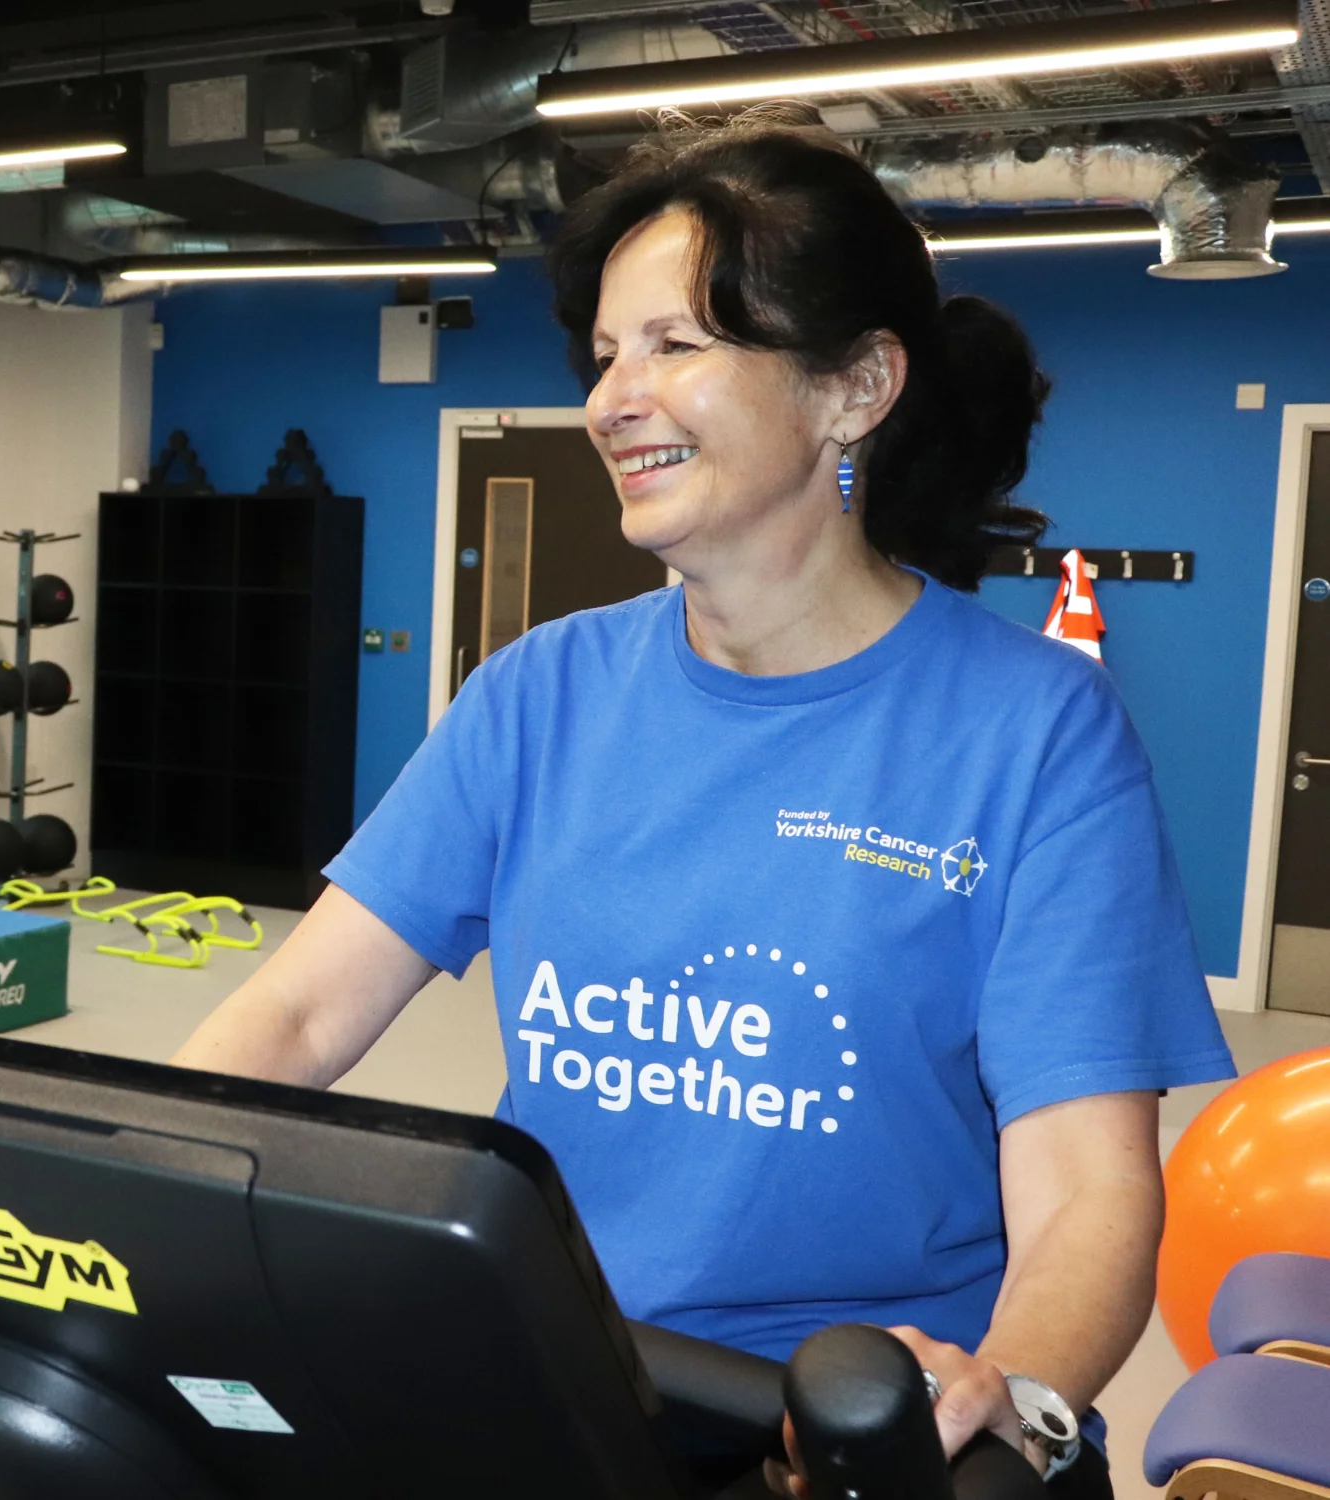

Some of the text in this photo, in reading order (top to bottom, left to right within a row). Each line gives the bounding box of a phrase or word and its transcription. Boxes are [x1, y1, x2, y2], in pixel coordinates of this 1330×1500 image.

[777, 808, 831, 821] Funded by
[775, 820, 939, 860] Yorkshire Cancer
[844, 843, 932, 880] Research
[518, 959, 772, 1058] Active
